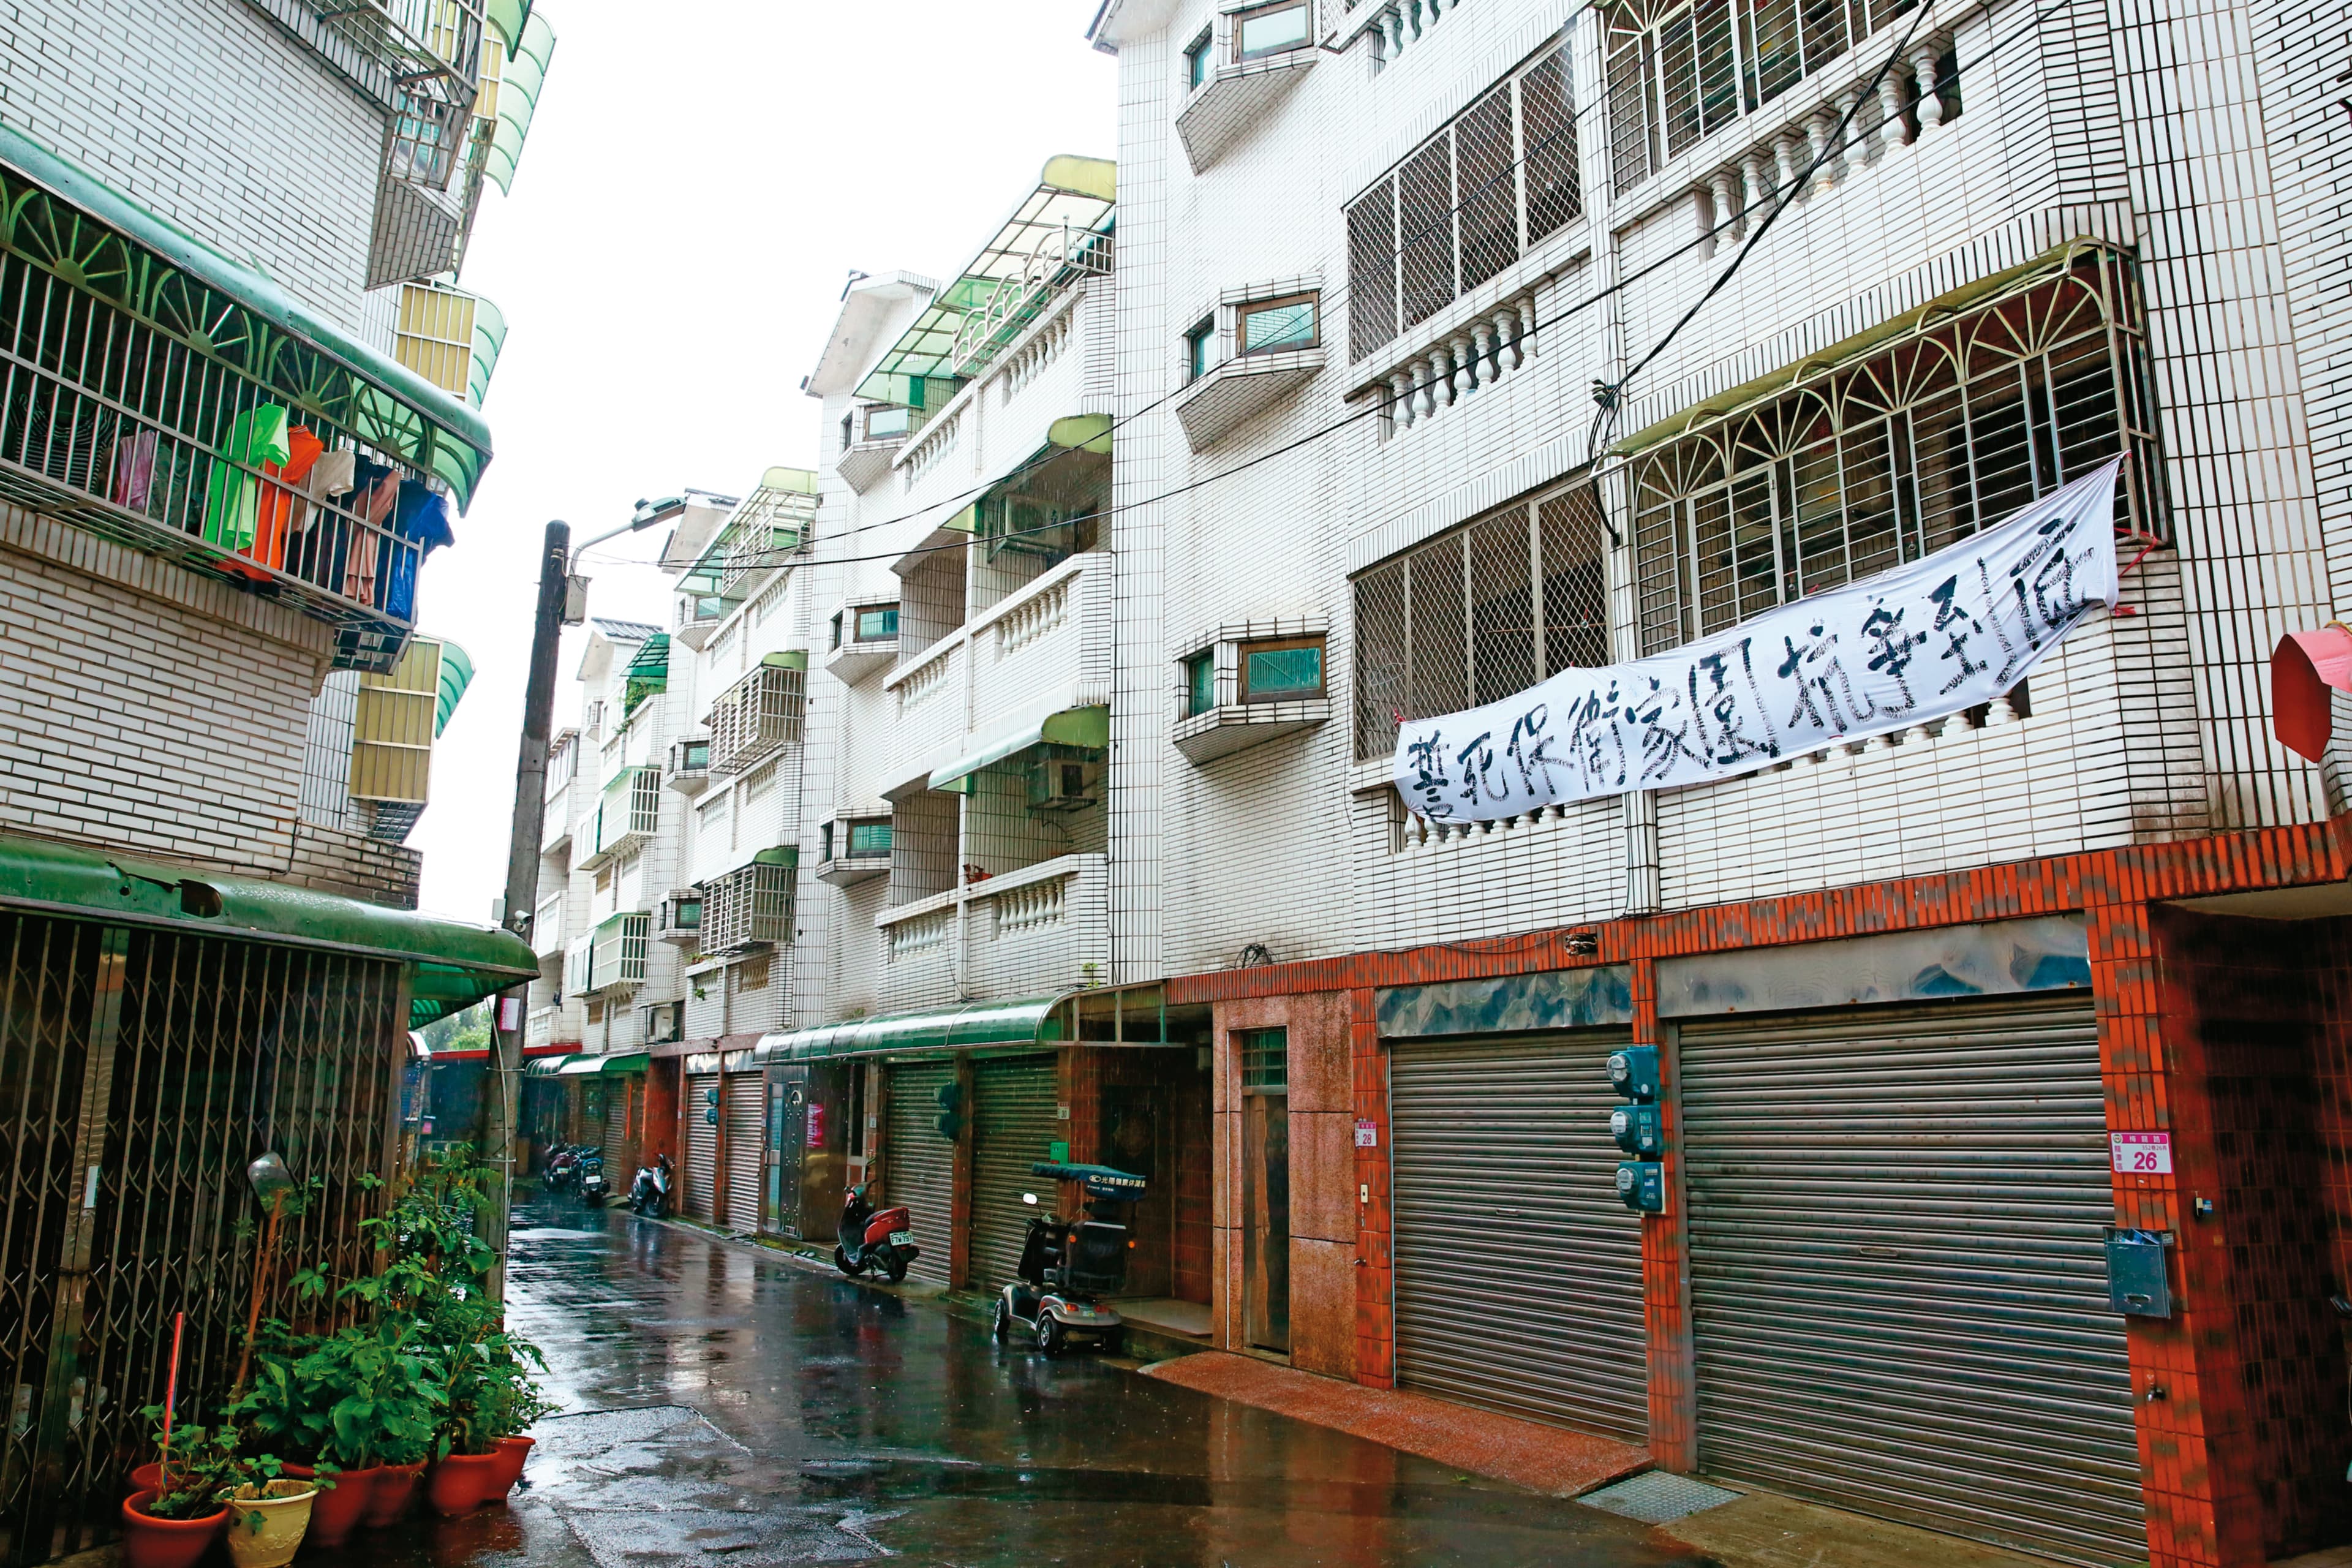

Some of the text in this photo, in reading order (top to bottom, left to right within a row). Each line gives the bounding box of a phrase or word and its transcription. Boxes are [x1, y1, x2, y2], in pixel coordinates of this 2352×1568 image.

[1408, 518, 2094, 823] 誓死保衛家園抗爭到底
[1363, 1133, 1371, 1144] 28
[2134, 1152, 2157, 1170] 26
